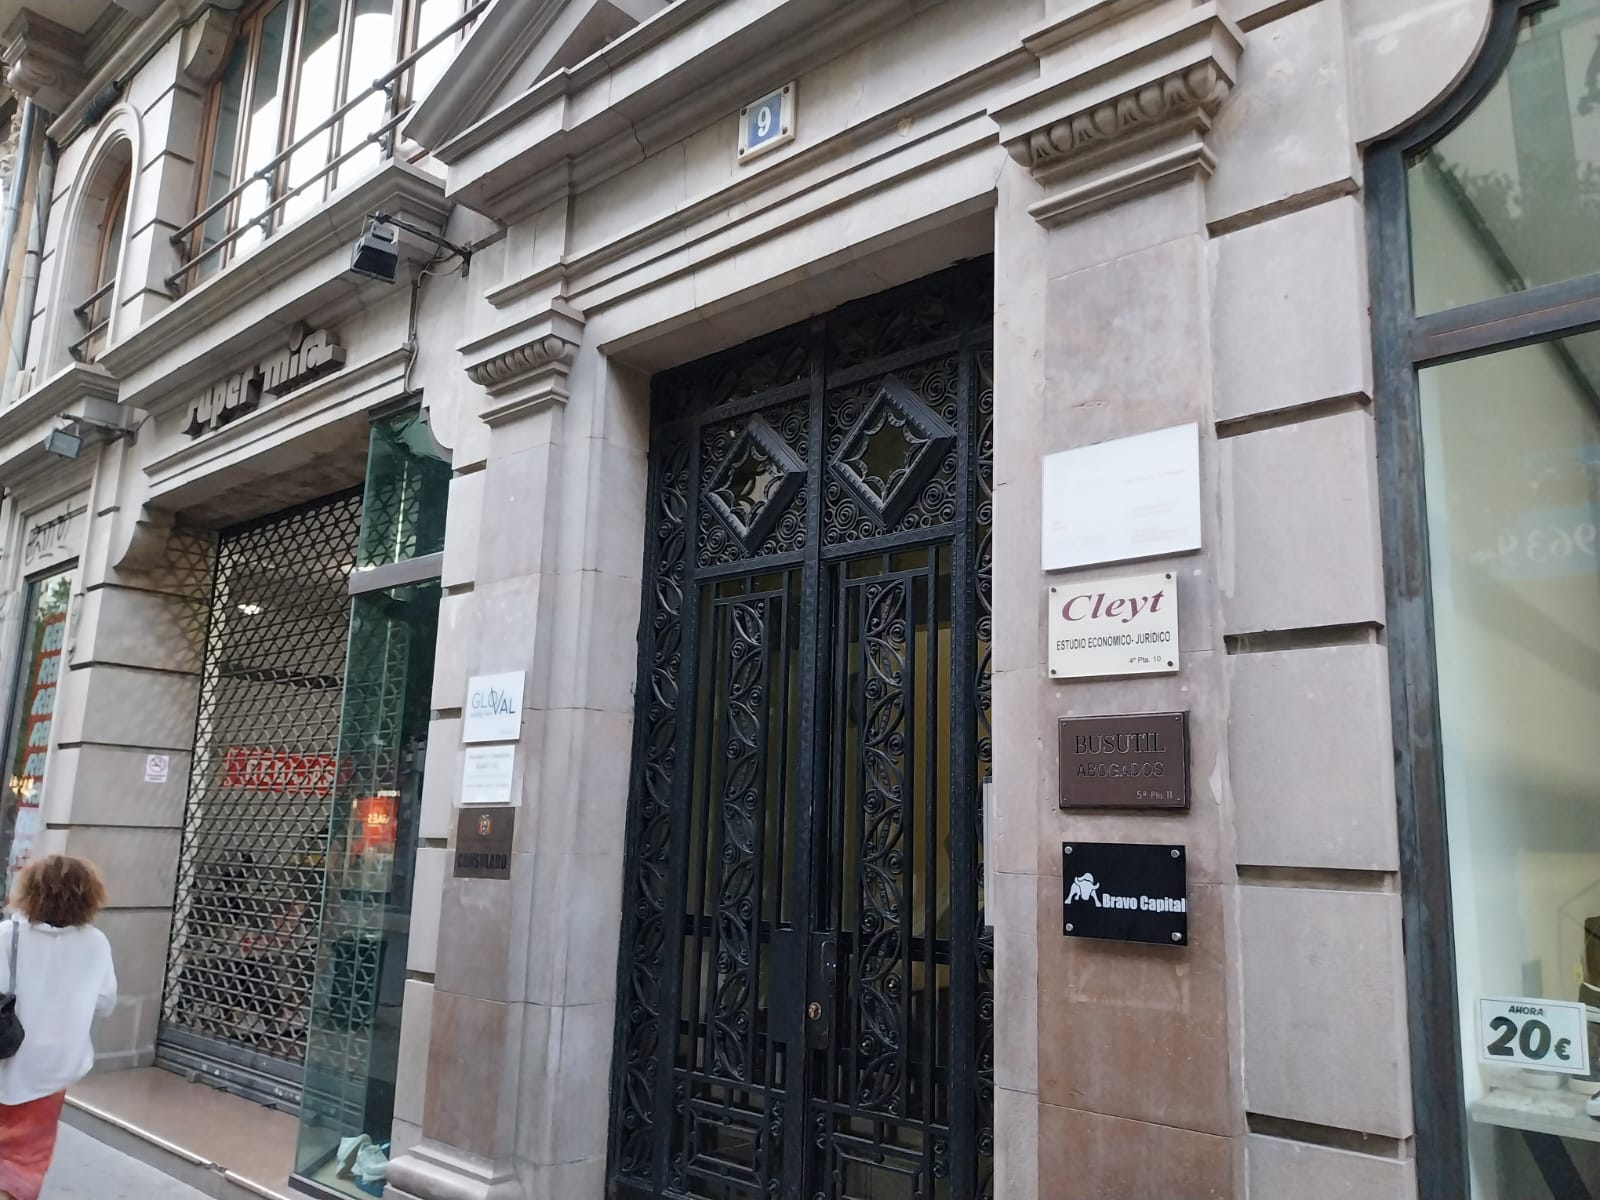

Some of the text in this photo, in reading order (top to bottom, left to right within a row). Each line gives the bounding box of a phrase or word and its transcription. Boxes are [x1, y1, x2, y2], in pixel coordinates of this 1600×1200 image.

[757, 106, 771, 137] 9
[1062, 590, 1164, 623] Cleyt
[1056, 638, 1086, 651] ESTUDIO
[472, 688, 515, 715] GLOVAL
[1074, 733, 1166, 754] BUSUTIL
[1077, 762, 1164, 777] ABOGADOS
[1102, 893, 1186, 912] Bravo Capital
[1508, 1006, 1544, 1016] AHORA
